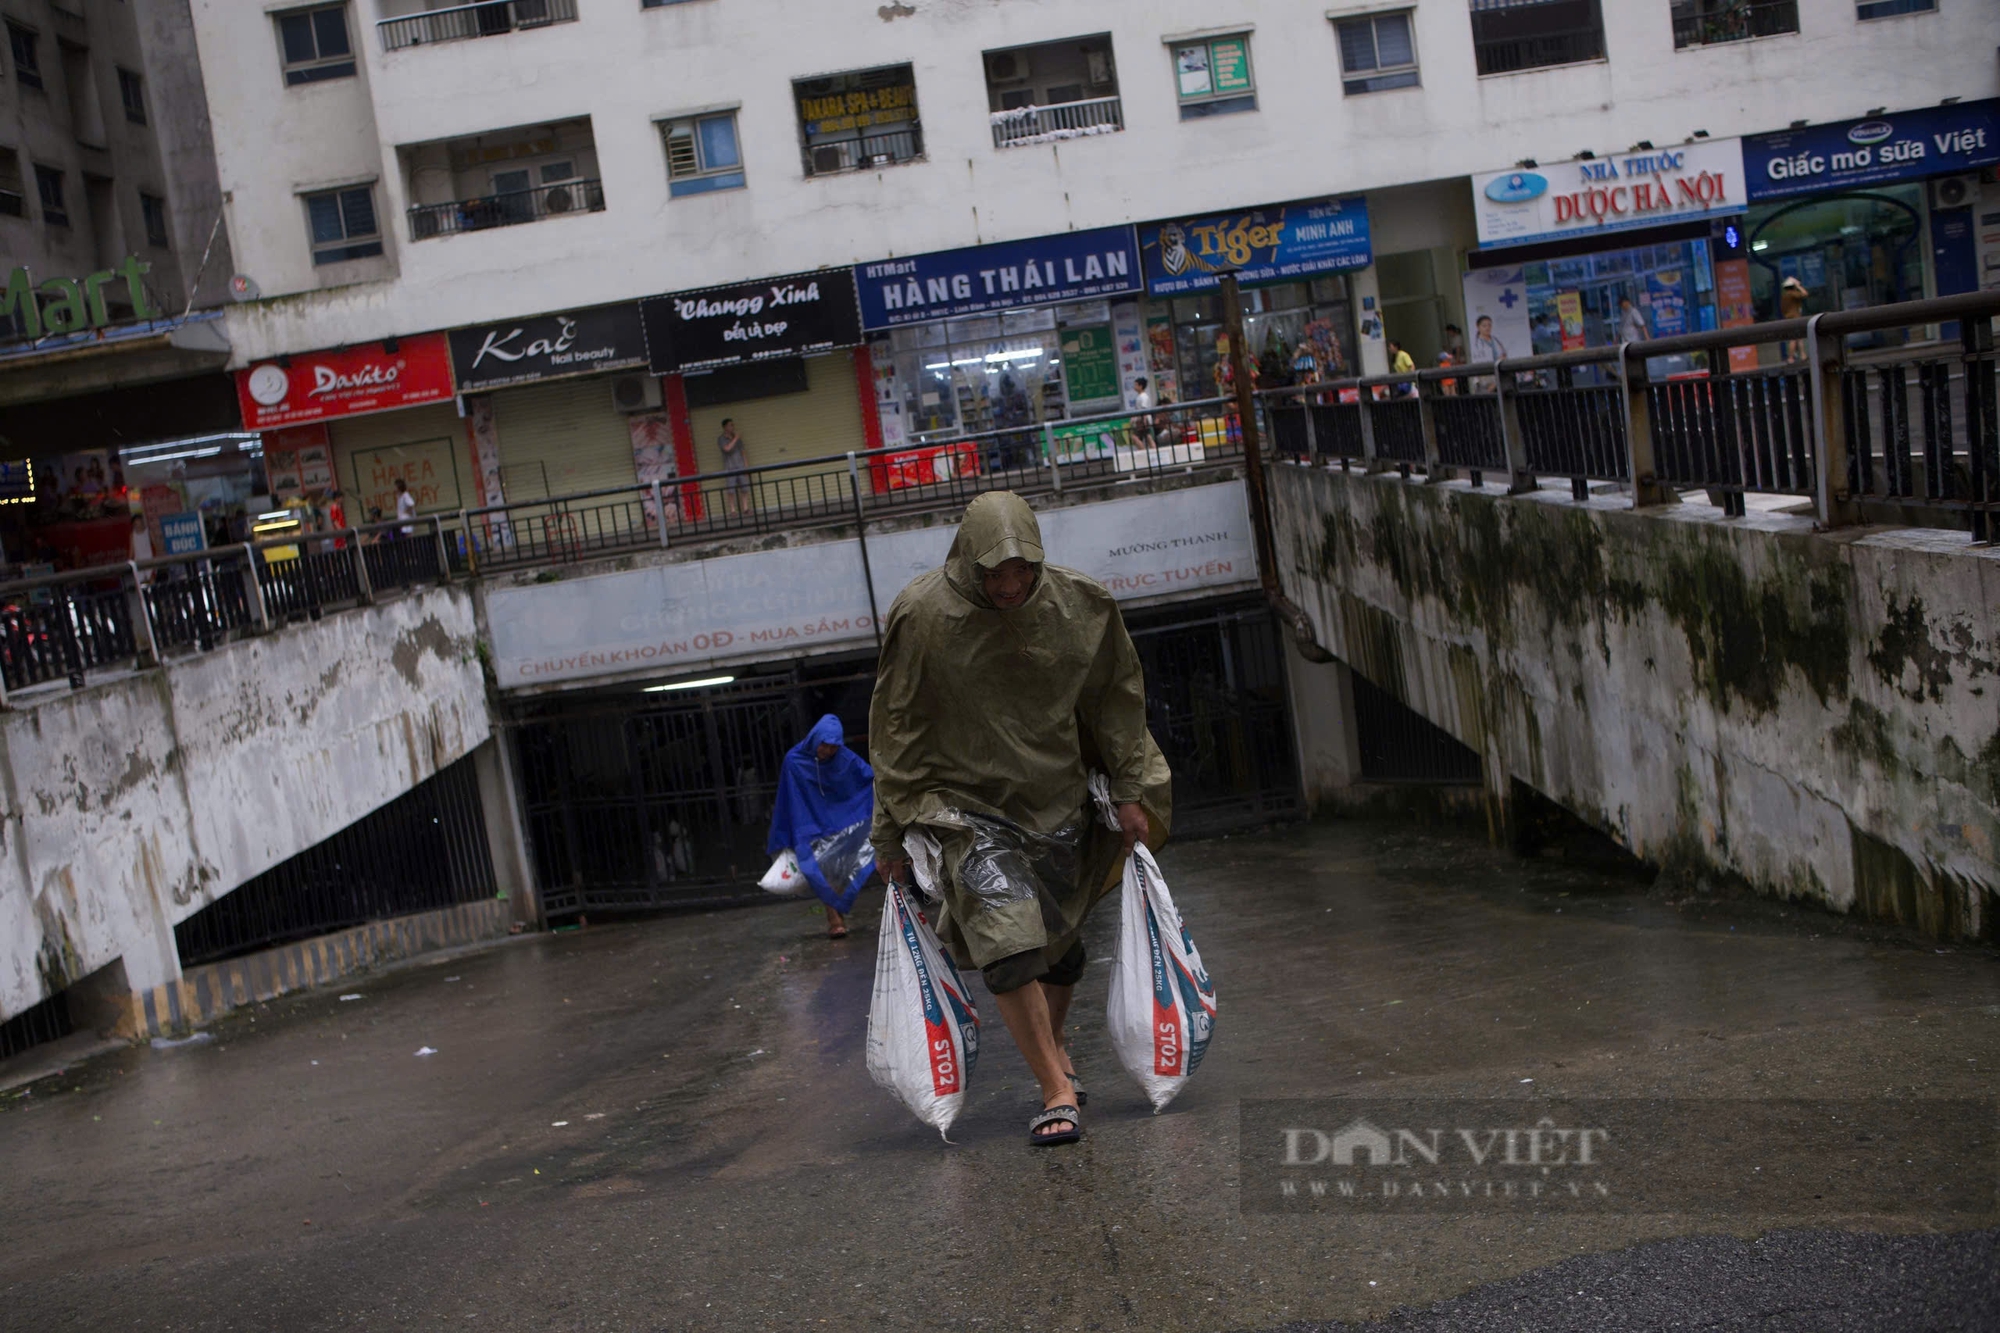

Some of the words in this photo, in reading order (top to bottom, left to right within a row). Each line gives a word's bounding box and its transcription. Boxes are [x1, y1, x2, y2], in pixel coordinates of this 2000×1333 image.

[1581, 156, 1619, 182] NHÀ
[1624, 150, 1684, 177] THUỐC
[1767, 150, 1825, 180] Giấc
[1831, 147, 1871, 170] mơ
[1879, 140, 1925, 163] sữa
[1934, 128, 1987, 155] Việt
[1554, 186, 1627, 224] DƯỢC
[1634, 174, 1672, 213] HÀ
[1678, 170, 1726, 211] NỘI
[1191, 216, 1285, 265] Tiger
[1295, 223, 1327, 242] MINH
[1329, 219, 1354, 237] ANH
[866, 260, 917, 279] HTMart
[882, 274, 972, 311] HÀNG
[980, 259, 1056, 295] THÁI
[1064, 250, 1128, 283] LAN
[769, 282, 820, 308] Xinh
[551, 352, 573, 366] Nail
[575, 347, 615, 363] beauty
[308, 363, 398, 398] Davito
[1170, 531, 1228, 548] THANH
[1163, 559, 1232, 582] TUYẾN
[751, 626, 799, 643] MUA
[911, 945, 923, 967] 12KG
[1154, 969, 1163, 992] 25KG
[1159, 1022, 1177, 1068] ST02
[934, 1039, 956, 1086] ST02
